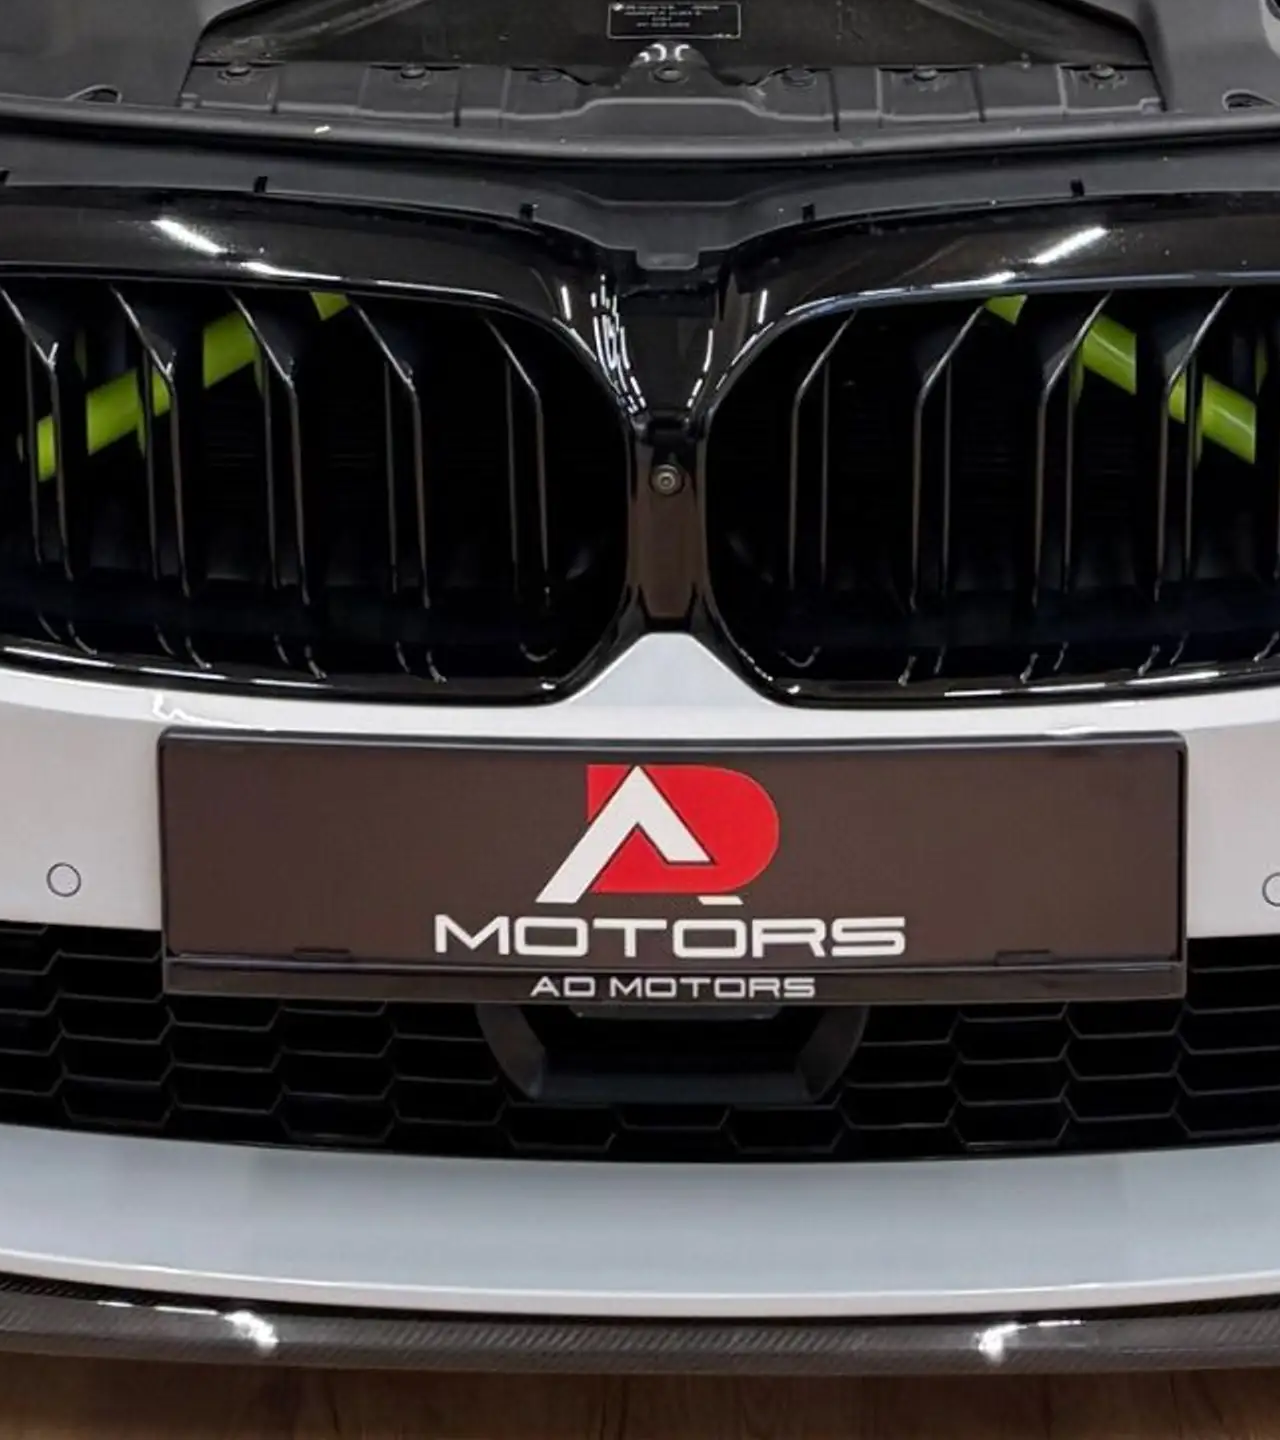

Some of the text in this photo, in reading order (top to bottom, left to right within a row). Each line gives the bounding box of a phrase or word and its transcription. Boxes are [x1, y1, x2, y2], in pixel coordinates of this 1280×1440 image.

[434, 914, 906, 958] MOTORS
[531, 976, 816, 999] AD MOTORS
